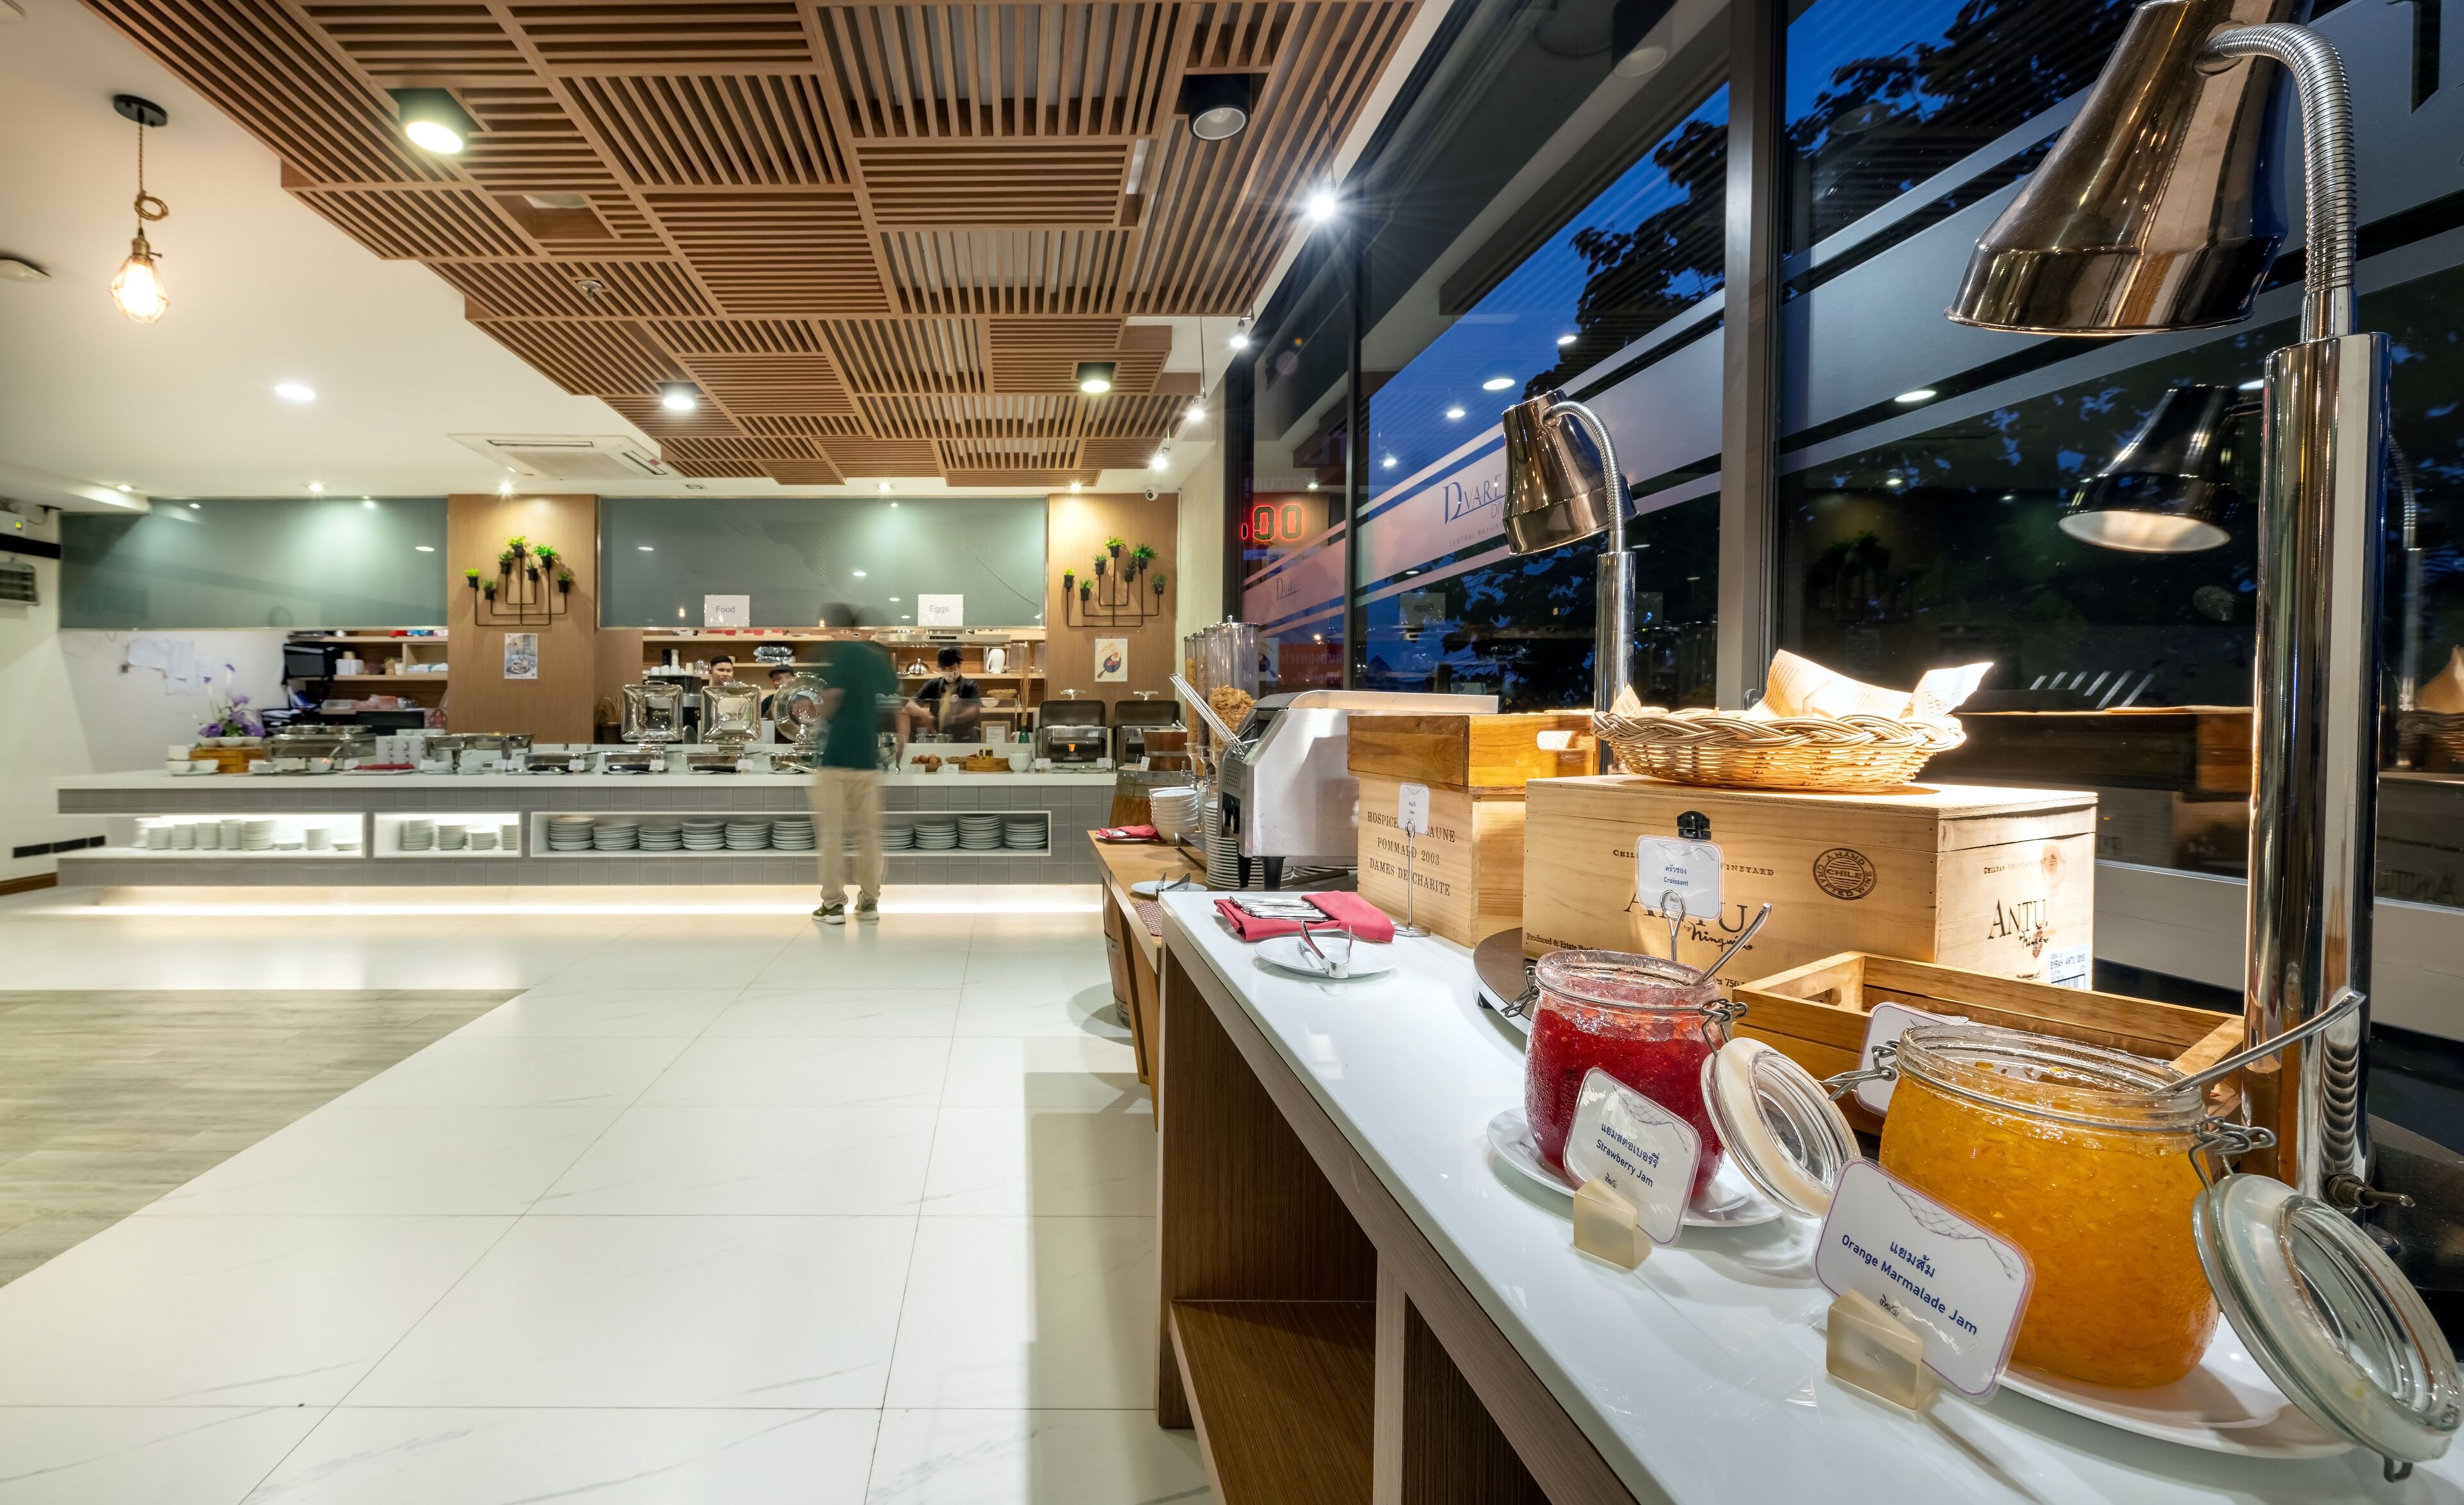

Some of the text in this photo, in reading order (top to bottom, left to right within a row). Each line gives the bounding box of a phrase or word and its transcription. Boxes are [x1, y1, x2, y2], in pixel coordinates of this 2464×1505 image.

[1443, 473, 1507, 526] DVARE
[1450, 533, 1475, 546] CENTRAL
[930, 605, 949, 614] Eggs
[1367, 812, 1398, 829] HOSPICE
[1421, 850, 1440, 865] 2003
[1835, 852, 1865, 865] HAND
[1370, 858, 1450, 896] DAMES DE CHARITE
[1663, 877, 1688, 886] Croissant
[1818, 864, 1854, 897] CRAFTED
[1827, 869, 1861, 879] CHILE
[1854, 871, 1872, 894] WINE
[1988, 899, 2046, 940] ANTU
[1526, 933, 1552, 945] Produced
[1559, 940, 1577, 950] Estate
[1725, 978, 1740, 988] 750
[1596, 1139, 1654, 1187] Strawberry Jam
[1890, 1242, 1935, 1278] แยมส้ม
[1842, 1235, 1978, 1336] Orange Marmalade Jam
